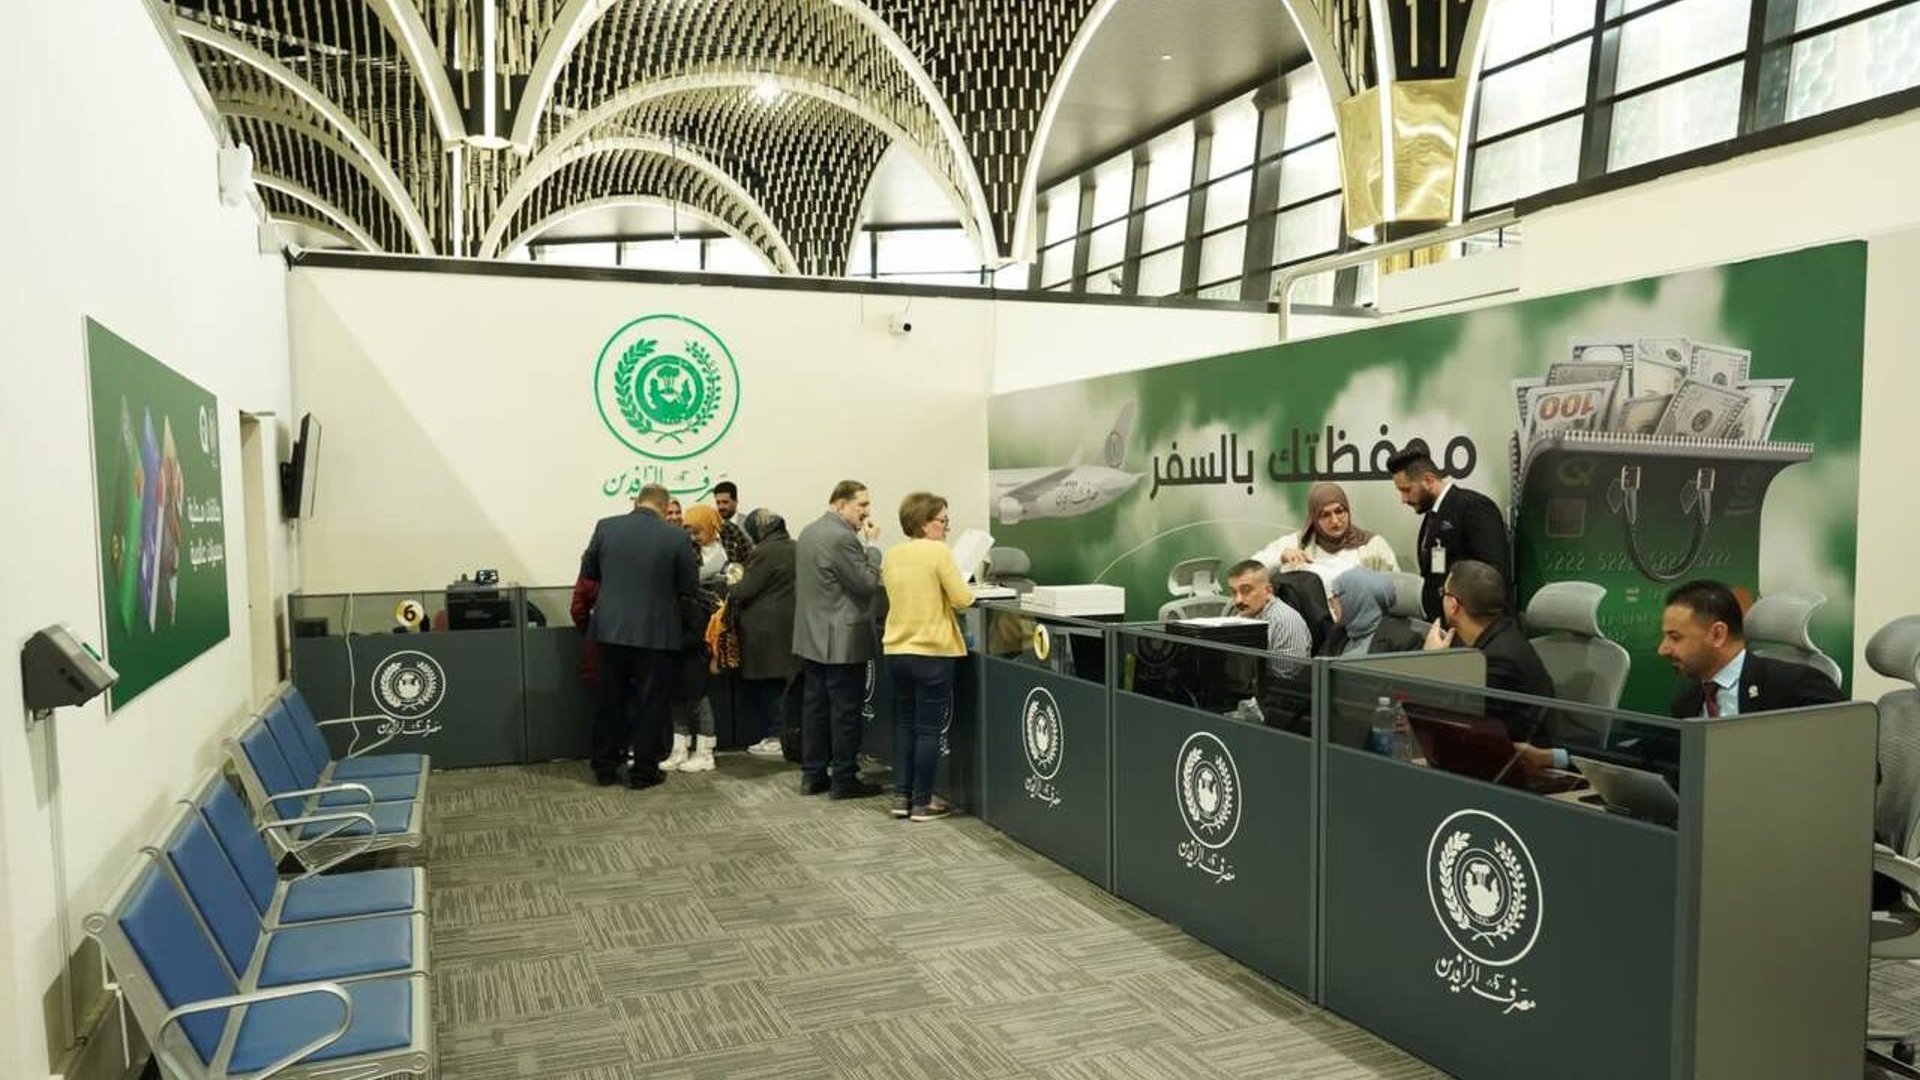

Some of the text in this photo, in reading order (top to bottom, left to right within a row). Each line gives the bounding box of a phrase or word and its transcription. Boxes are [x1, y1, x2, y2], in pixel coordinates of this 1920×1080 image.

[1149, 423, 1477, 501] مفظتك بالسفر
[403, 604, 416, 622] 6
[1037, 631, 1044, 653] 1
[1435, 953, 1537, 1015] مصرف الرافدين
